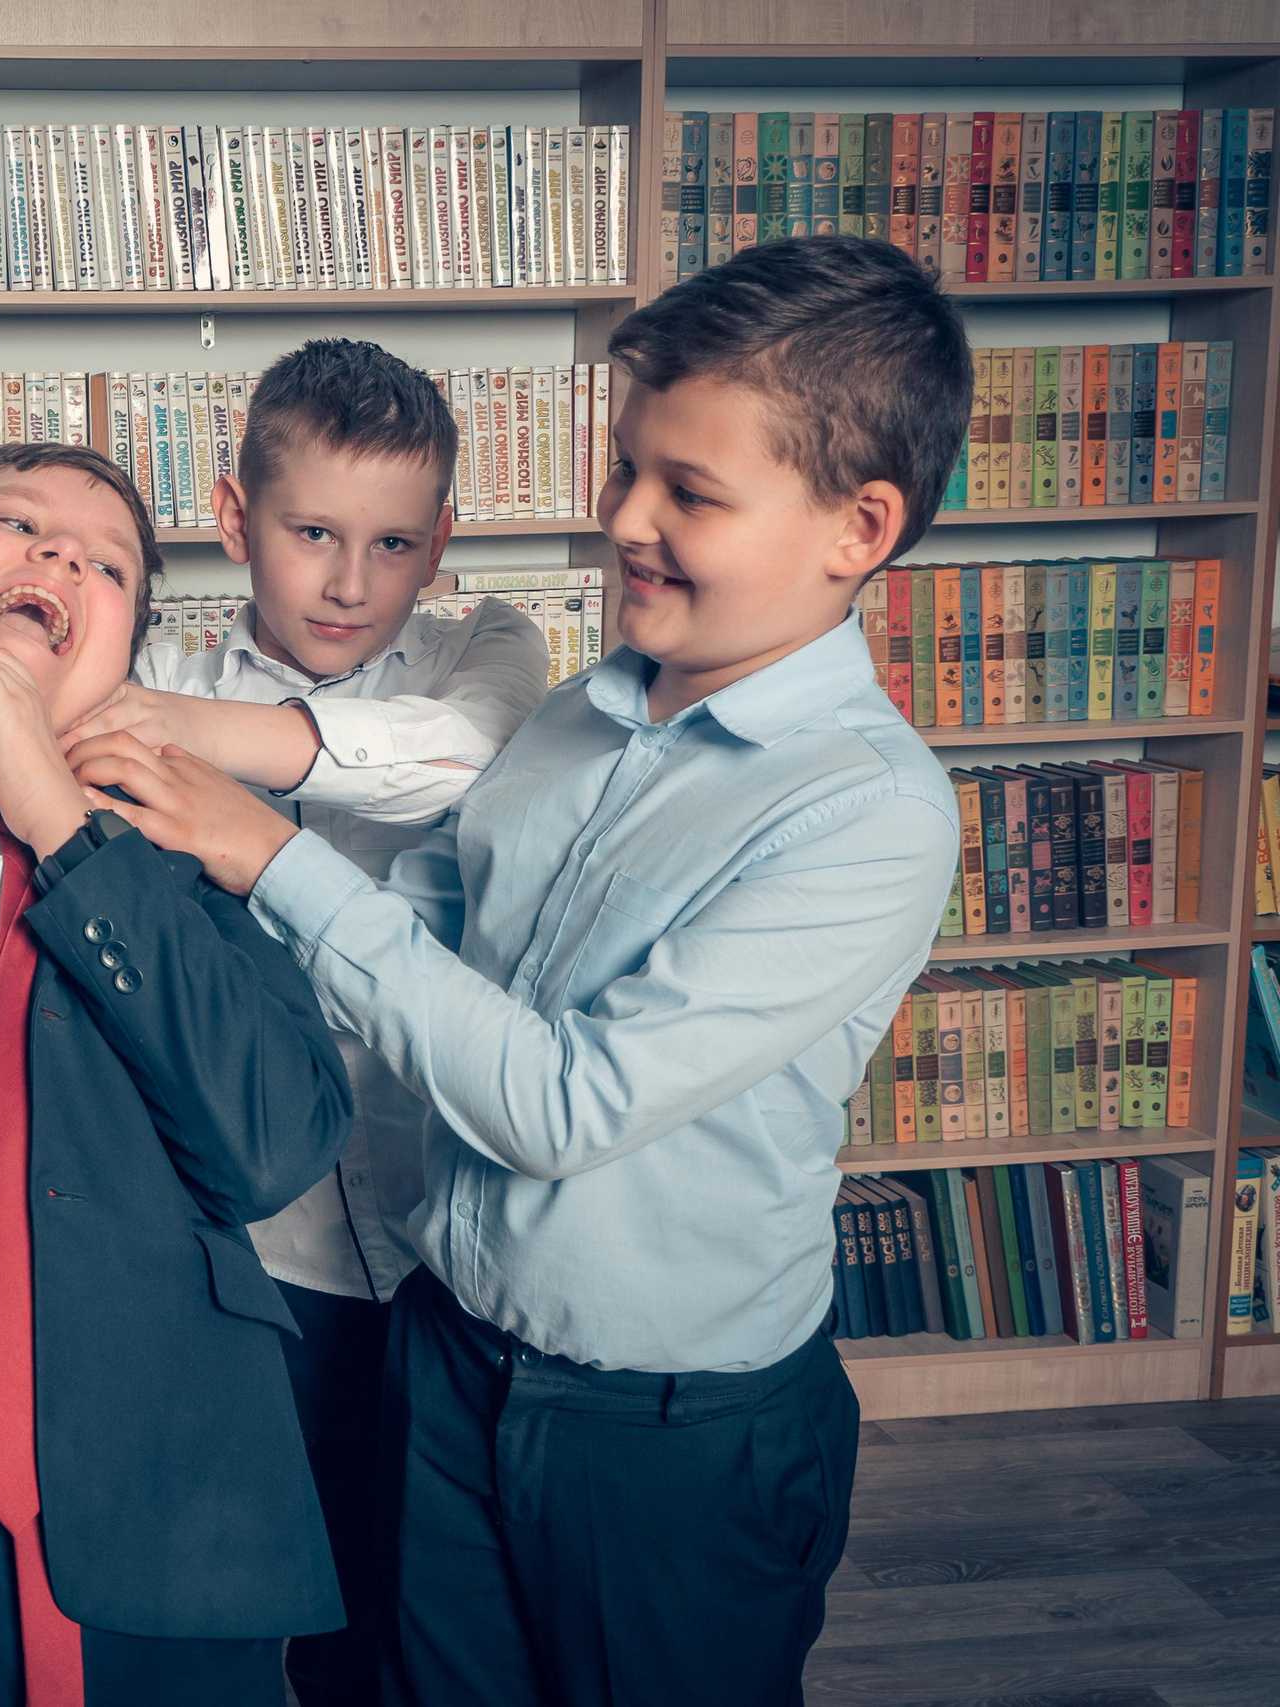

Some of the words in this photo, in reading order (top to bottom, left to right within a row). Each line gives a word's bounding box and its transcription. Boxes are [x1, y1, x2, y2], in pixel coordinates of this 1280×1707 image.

[229, 158, 242, 193] МИР
[314, 160, 327, 192] МИР
[387, 152, 401, 184] МИР
[474, 158, 487, 192] МИР
[494, 164, 506, 194] МИР
[571, 165, 583, 194] МИР
[594, 166, 606, 196] МИР
[497, 198, 509, 256] ПОЗНАЮ
[571, 199, 584, 254] ПОЗНАЮ
[594, 200, 606, 256] ПОЗНАЮ
[152, 404, 167, 435] МИР
[474, 401, 487, 431] МИР
[494, 401, 506, 430] МИР
[516, 391, 529, 421] МИР
[536, 398, 549, 429] МИР
[558, 400, 569, 428] МИР
[174, 408, 188, 438] МИР
[155, 441, 171, 501] ПОЗНАЮ
[176, 442, 192, 497] ПОЗНАЮ
[476, 436, 491, 494] ПОЗНАЮ
[495, 433, 509, 490] ПОЗНАЮ
[517, 425, 530, 488] ПОЗНАЮ
[536, 433, 551, 493] ПОЗНАЮ
[558, 432, 571, 486] ПОЗНАЮ
[136, 446, 152, 501] ПОЗНАЮ
[179, 499, 193, 510] Я
[478, 497, 492, 508] Я
[496, 493, 509, 504] Я
[518, 494, 531, 503] Я
[537, 496, 552, 507] Я
[558, 488, 571, 498] Я
[158, 504, 171, 515] Я
[475, 576, 485, 589] Я
[488, 574, 539, 589] ПОЗНАЮ
[543, 573, 569, 588] МИР
[549, 627, 561, 655] МИР
[587, 625, 599, 653] МИР
[1088, 1170, 1098, 1198] ЯЗЫКА
[1092, 1200, 1102, 1240] РУССКОГО
[1125, 1167, 1142, 1242] ЭНЦИКЛОПЕДИЯ
[1096, 1241, 1105, 1277] СЛОВАРЬ
[1235, 1256, 1243, 1287] Большая
[1128, 1246, 1138, 1315] ПОПУЛЯРНАЯ
[1136, 1245, 1146, 1314] ХУДОЖЕСТВЕННАЯ
